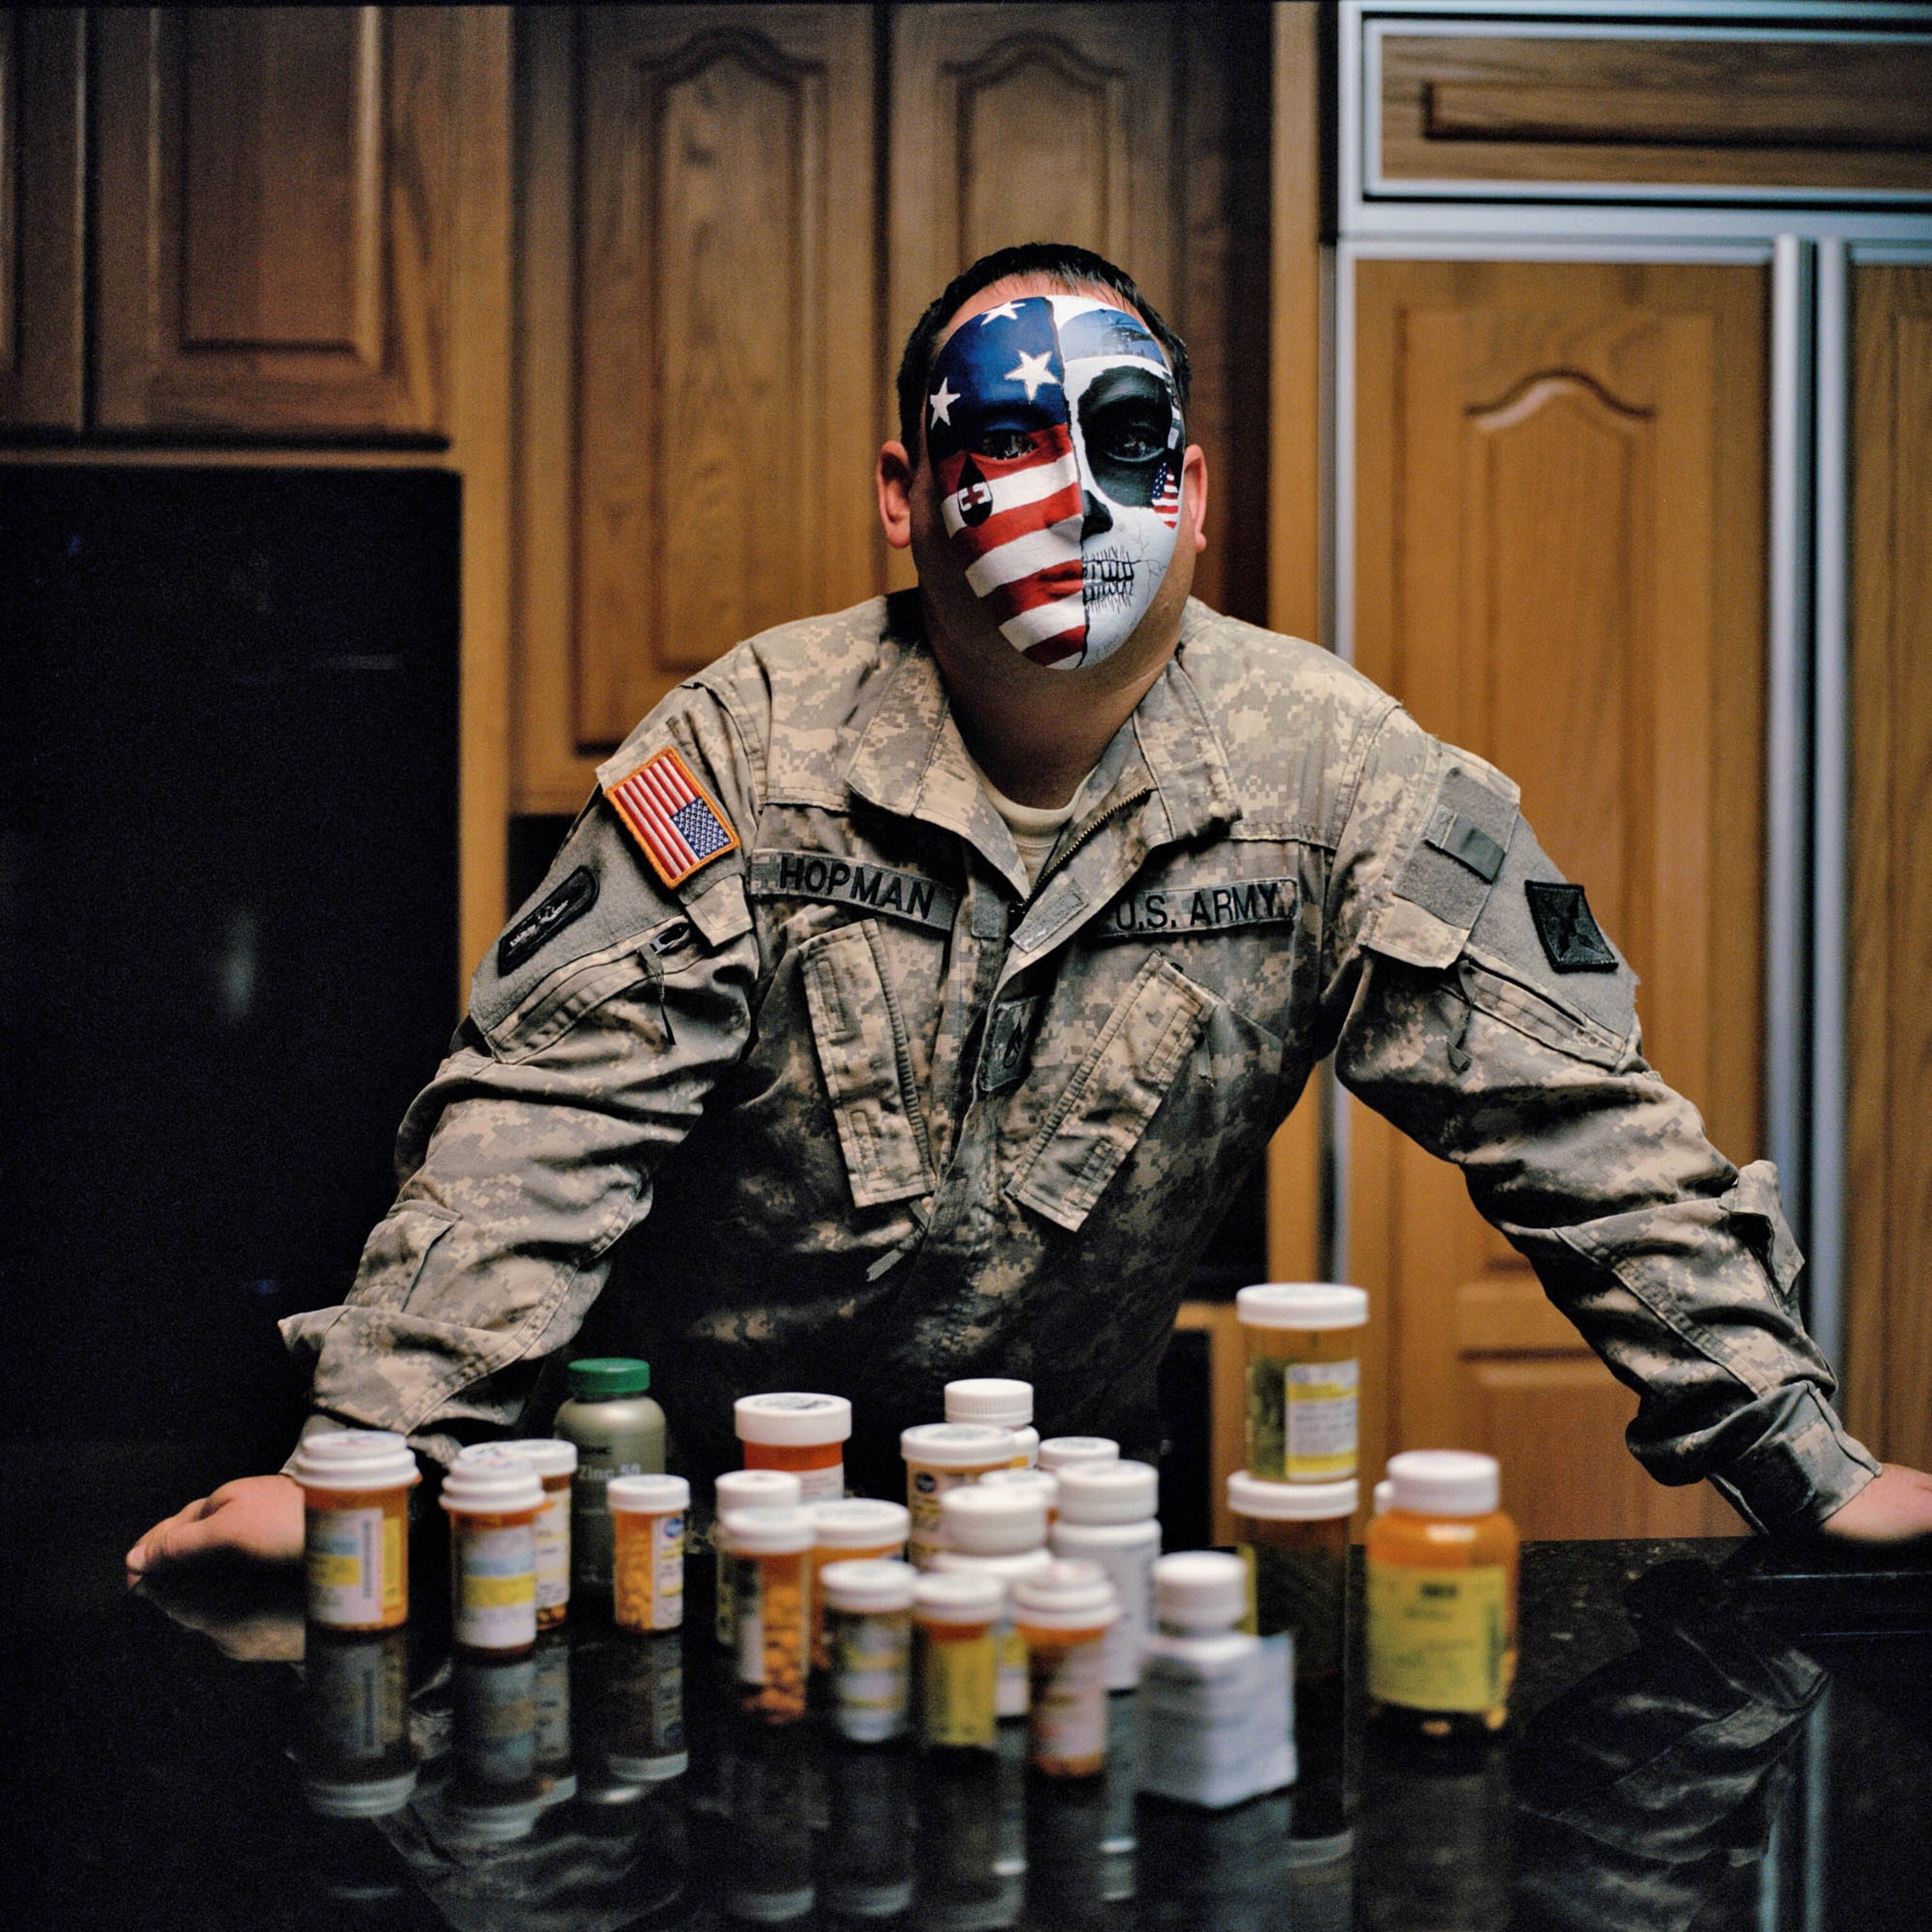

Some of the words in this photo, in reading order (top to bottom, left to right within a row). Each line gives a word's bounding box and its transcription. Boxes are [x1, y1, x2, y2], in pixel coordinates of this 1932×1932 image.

[780, 856, 935, 919] HOPMAN
[1116, 894, 1177, 931] U.S.
[1191, 882, 1277, 927] ARMY
